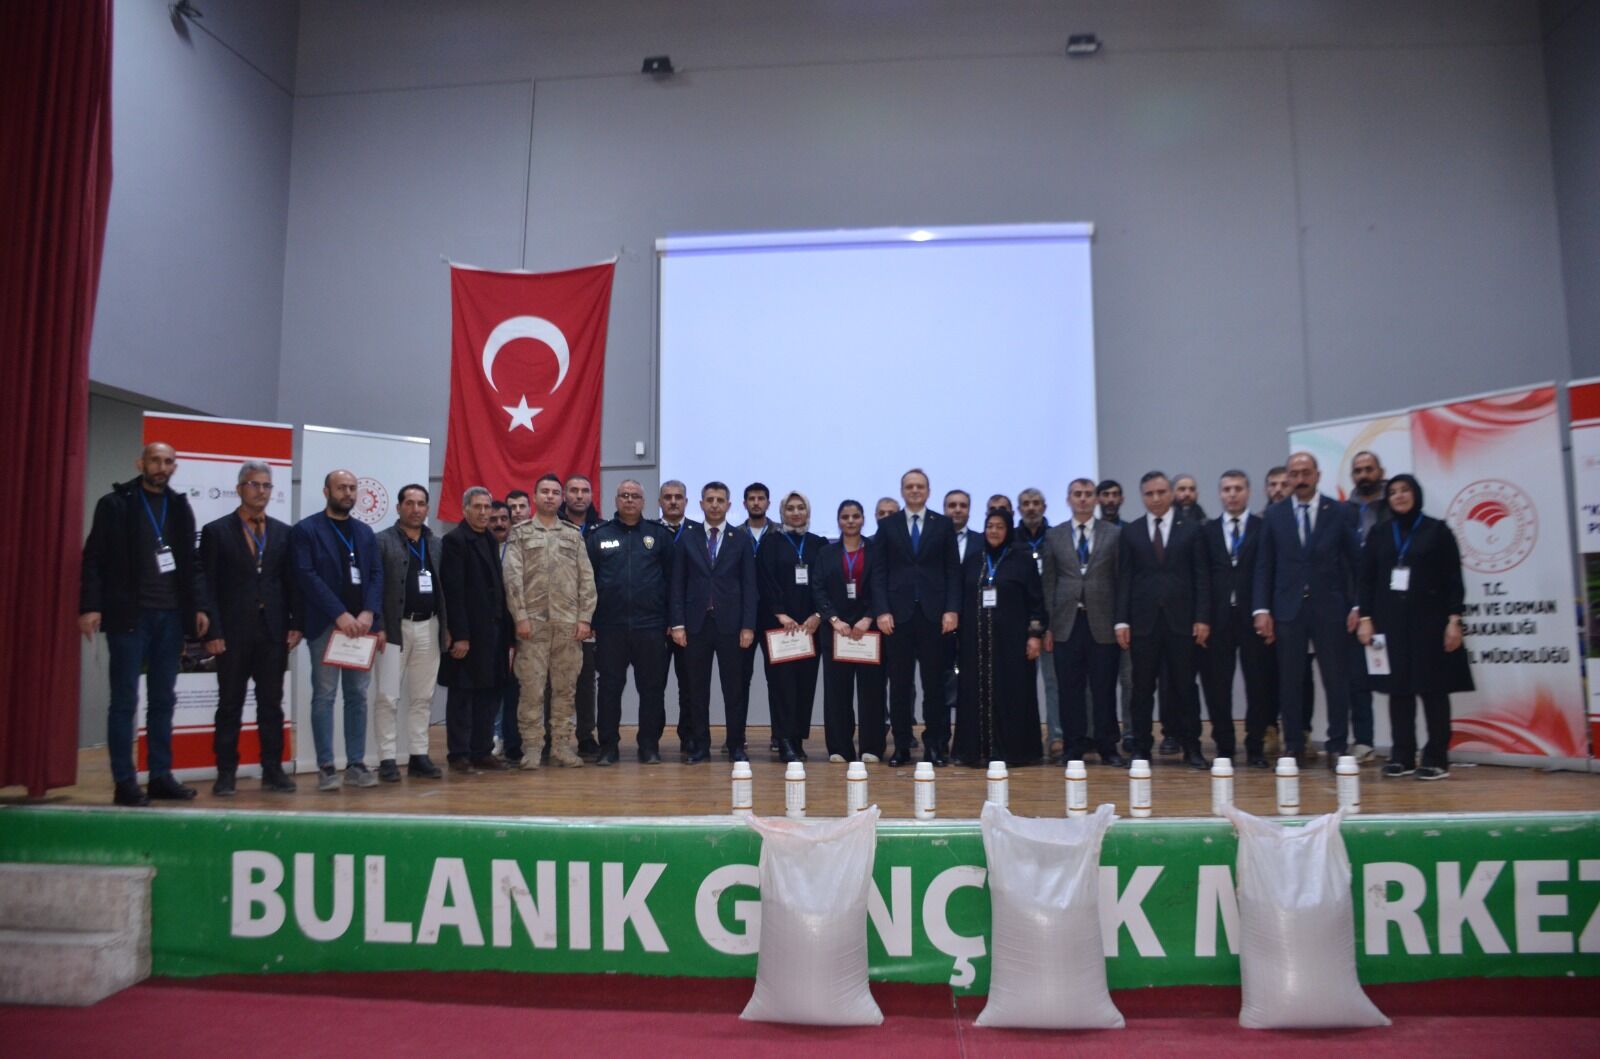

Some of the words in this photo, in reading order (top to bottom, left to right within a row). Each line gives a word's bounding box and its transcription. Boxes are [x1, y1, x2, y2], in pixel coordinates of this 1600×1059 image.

[1484, 601, 1502, 616] VE
[1503, 599, 1557, 616] ORMAN
[1480, 646, 1571, 664] MÜDÜRLÜĞÜ
[230, 849, 670, 953] BULANIK
[694, 863, 1167, 988] GNÇK
